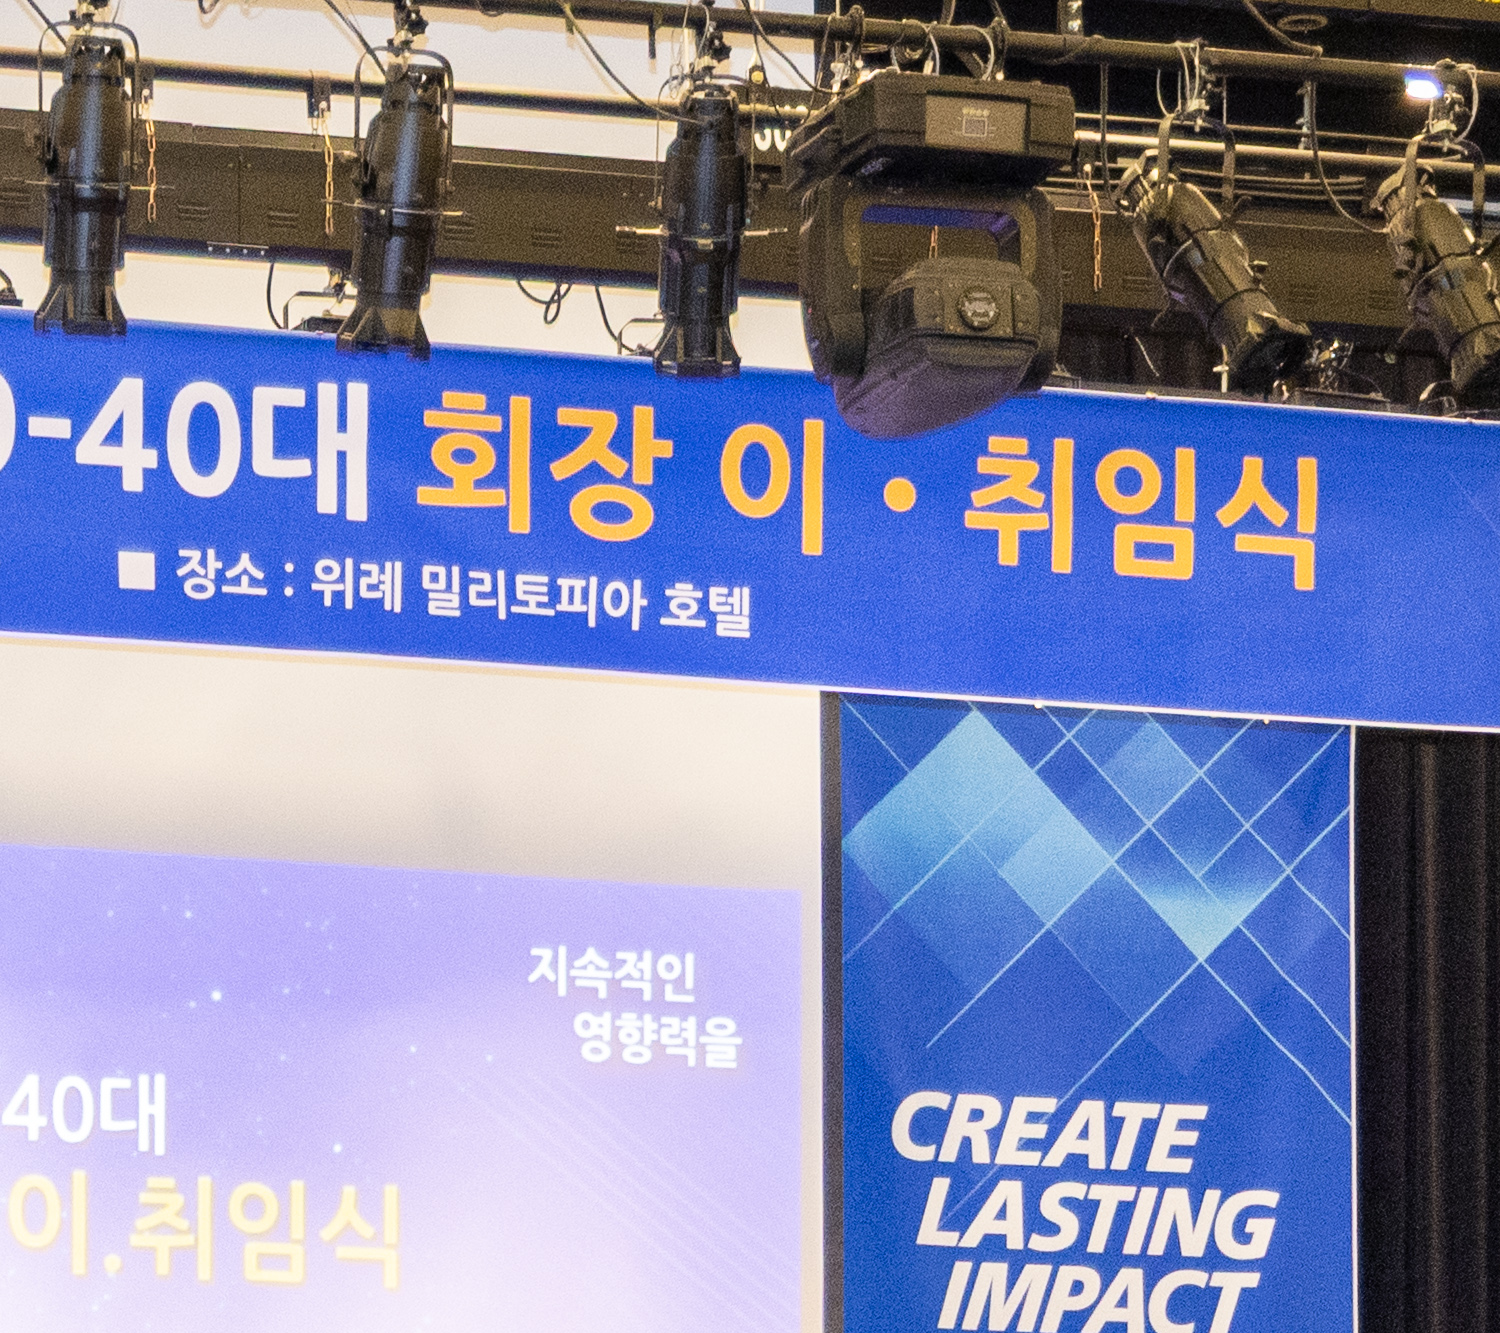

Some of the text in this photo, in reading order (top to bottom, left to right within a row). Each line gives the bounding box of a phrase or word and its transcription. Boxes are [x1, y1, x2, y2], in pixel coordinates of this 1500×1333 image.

[417, 391, 673, 542] 회장
[720, 419, 824, 556] 이
[964, 436, 1318, 591] 취임식
[177, 548, 267, 599] 장소
[312, 558, 402, 613] 위례
[422, 565, 648, 631] 밀리토피아
[660, 583, 750, 638] 호텔
[528, 946, 696, 1002] 지속적인
[572, 1012, 743, 1069] 영향력을
[892, 1091, 1208, 1173] CREATE
[917, 1177, 1280, 1260] LASTING
